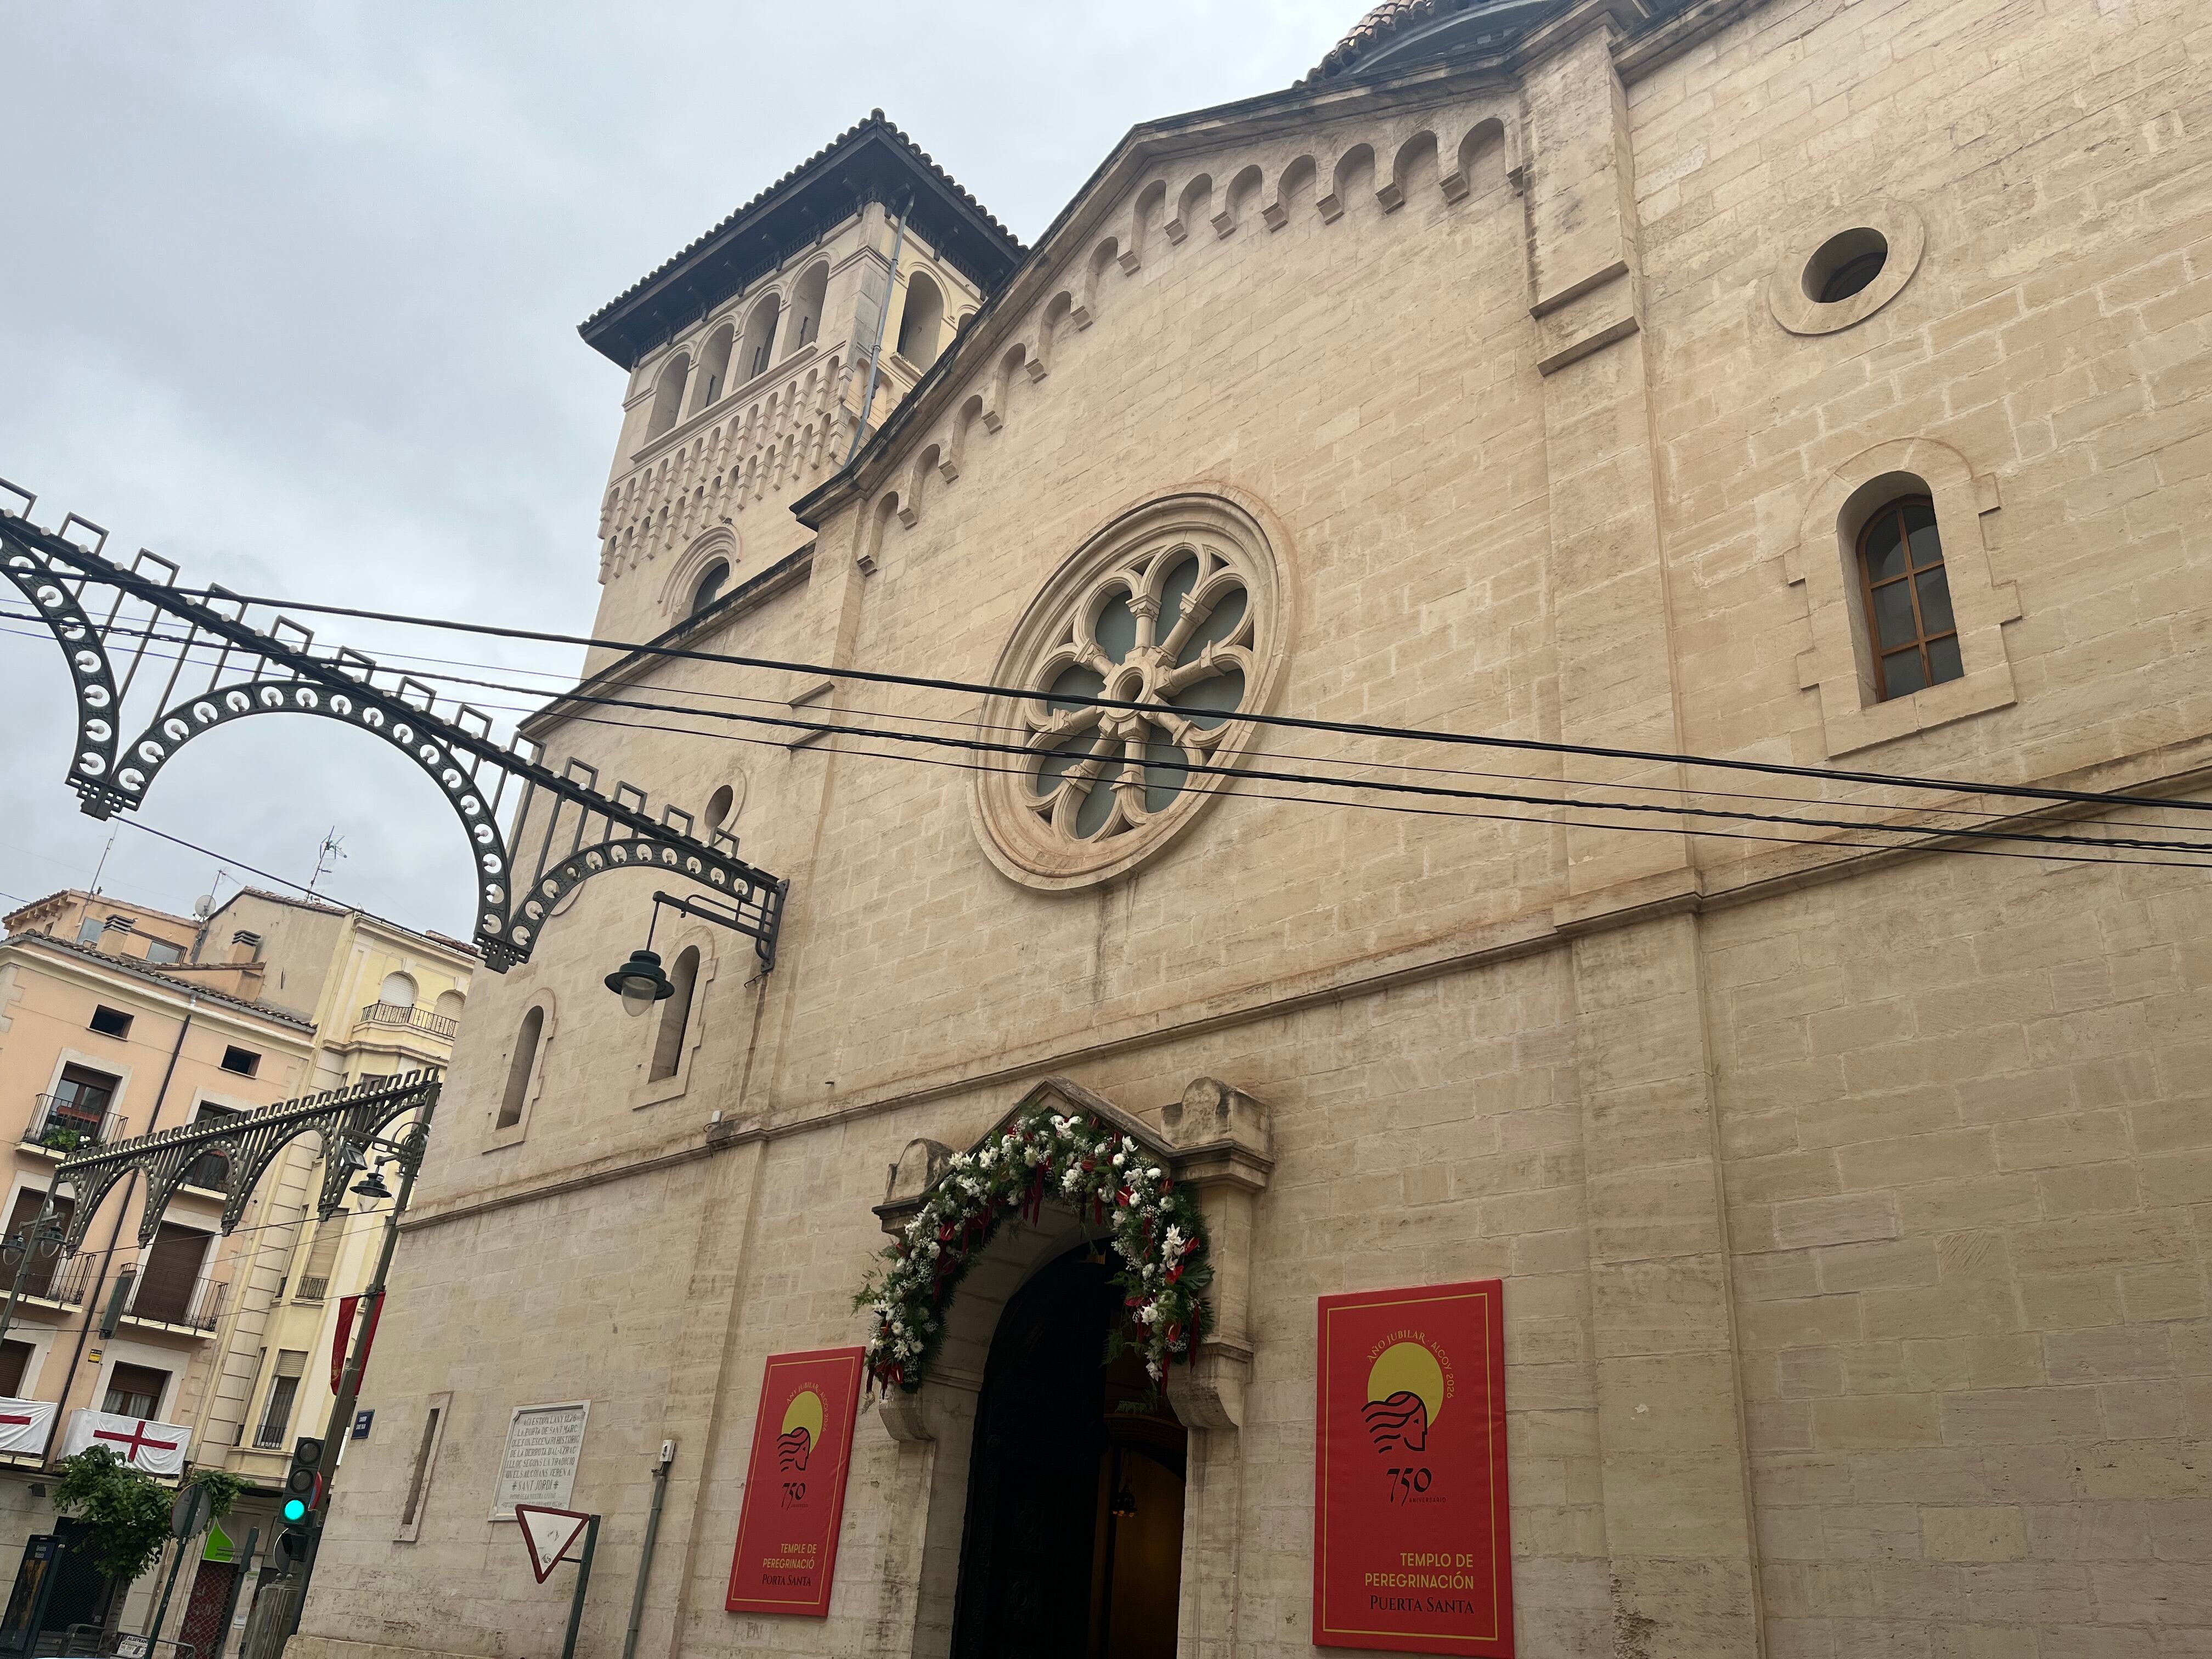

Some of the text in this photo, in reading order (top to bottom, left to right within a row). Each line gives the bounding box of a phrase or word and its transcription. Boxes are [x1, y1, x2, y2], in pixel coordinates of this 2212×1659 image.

[1367, 1330, 1454, 1398] AÑO JUBILAR ALCOY 2026
[786, 1388, 797, 1404] ANY
[798, 1382, 819, 1393] JUBILAR
[820, 1391, 828, 1412] ALCOI
[564, 1414, 577, 1423] 1276
[525, 1427, 540, 1436] PORTA
[541, 1426, 549, 1435] DE
[549, 1426, 563, 1434] SANT
[564, 1425, 578, 1434] MARC
[524, 1448, 547, 1457] DERROTA
[518, 1480, 552, 1491] SANT JORDI
[1386, 1468, 1432, 1506] 750
[781, 1482, 806, 1510] 750
[781, 1543, 817, 1554] TEMPLE DE
[763, 1556, 815, 1569] PEREGRINACIÓ
[1400, 1553, 1473, 1567] TEMPLO DE
[762, 1573, 811, 1586] PORTA SANTA
[1365, 1571, 1474, 1589] PEREGRINACIÓN
[1370, 1595, 1475, 1614] PUERTA SANTA
